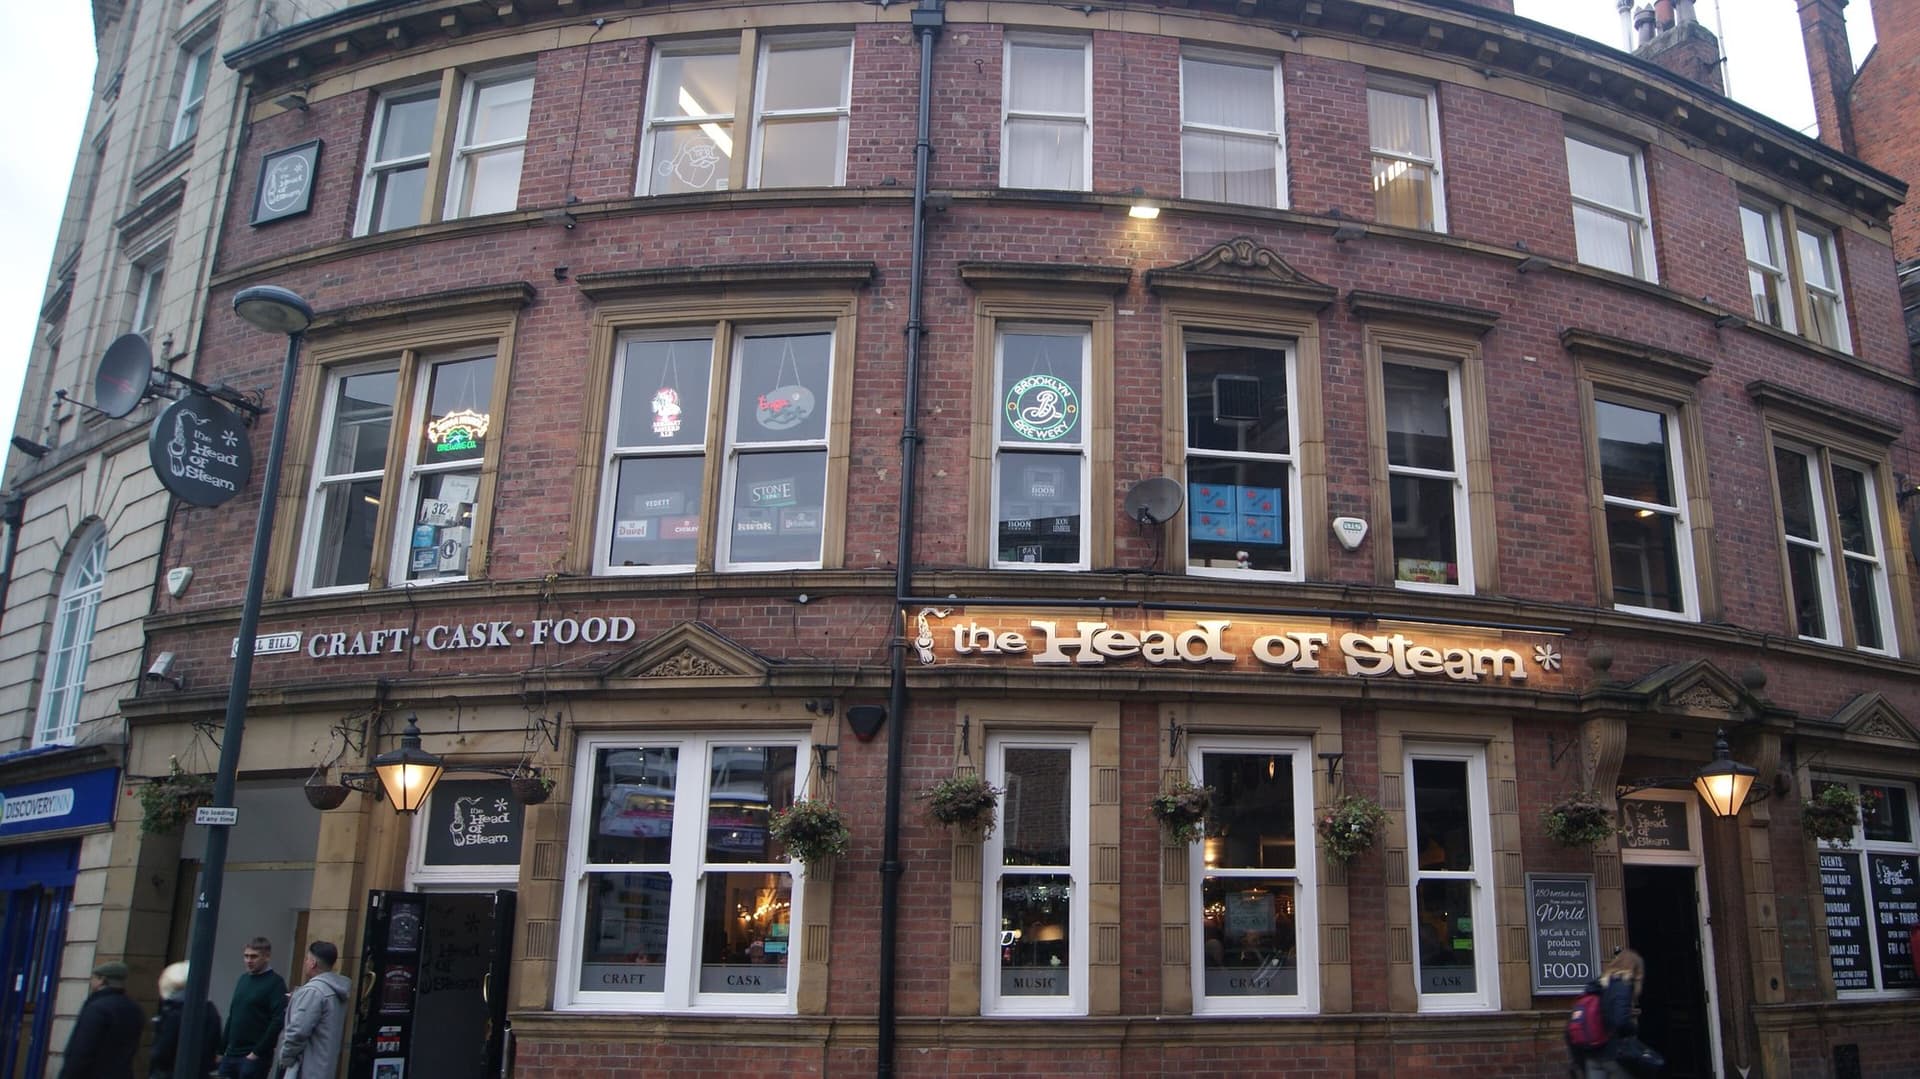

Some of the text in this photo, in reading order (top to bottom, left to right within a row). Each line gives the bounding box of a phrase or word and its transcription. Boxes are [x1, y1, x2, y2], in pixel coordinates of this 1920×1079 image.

[1015, 377, 1071, 397] BROOKLYN
[1014, 420, 1068, 439] BREWERY
[191, 441, 239, 467] Head
[185, 464, 235, 491] Steam
[752, 483, 791, 502] STONE
[432, 502, 448, 516] 312
[619, 526, 645, 536] Duvel
[268, 637, 292, 649] HILL
[308, 616, 637, 658] CRAFT CASK FOOD
[952, 621, 1029, 654] the
[1030, 620, 1237, 665] Head
[1339, 632, 1528, 683] Steam
[211, 809, 235, 817] loading
[470, 812, 510, 824] Head
[466, 834, 508, 845] Steam
[1820, 855, 1842, 867] EVENTS
[1536, 903, 1585, 922] World
[1844, 916, 1860, 927] NIGHT
[1547, 938, 1580, 949] products
[1847, 944, 1860, 955] JAZZ
[1558, 949, 1580, 957] draught
[1544, 963, 1589, 978] FOOD
[602, 973, 646, 985] CRAFT
[727, 974, 761, 986] CASK
[1014, 977, 1057, 989] MUSIC
[1230, 978, 1270, 989] CRAFT
[1432, 975, 1463, 987] CASK
